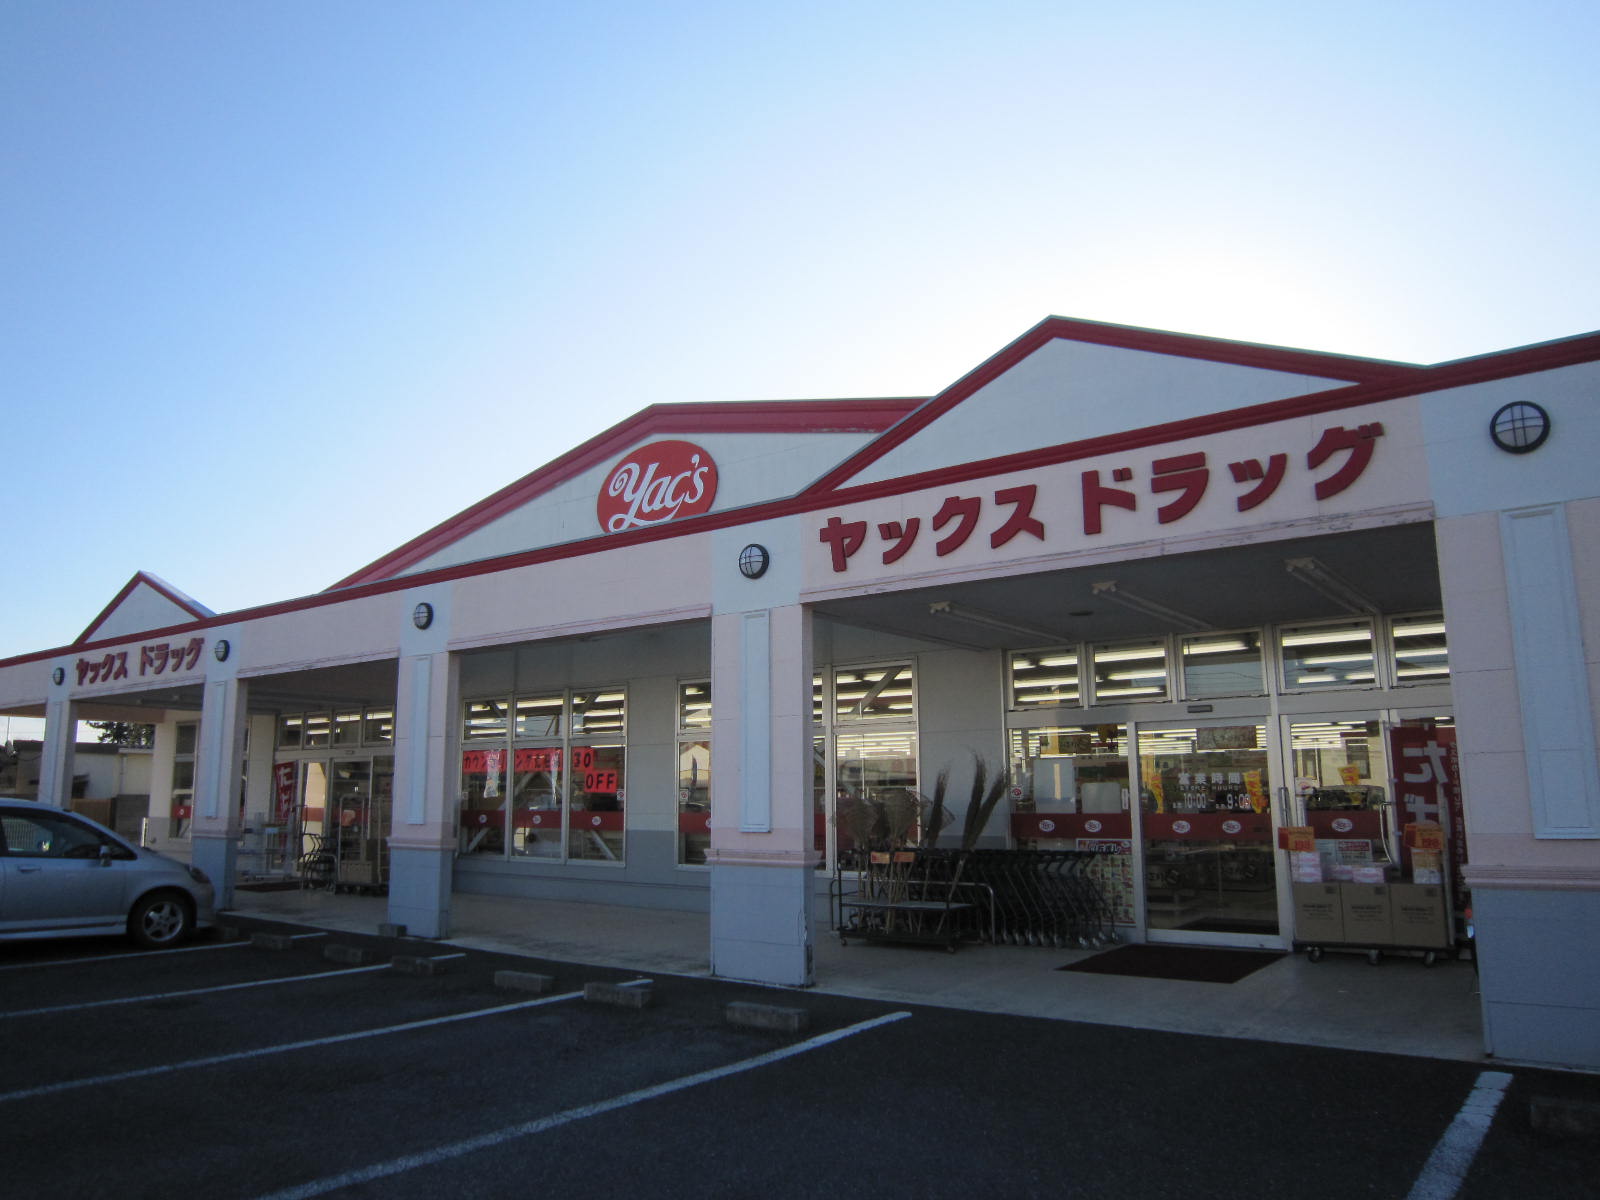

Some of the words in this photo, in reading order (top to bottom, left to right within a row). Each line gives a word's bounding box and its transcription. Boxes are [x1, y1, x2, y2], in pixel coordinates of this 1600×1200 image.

[608, 454, 709, 533] Yac's
[820, 484, 1044, 572] ヤックス
[1081, 421, 1385, 535] ドラッグ
[76, 651, 128, 686] ヤックス
[140, 637, 205, 676] ドラッグ
[585, 773, 615, 789] OFF
